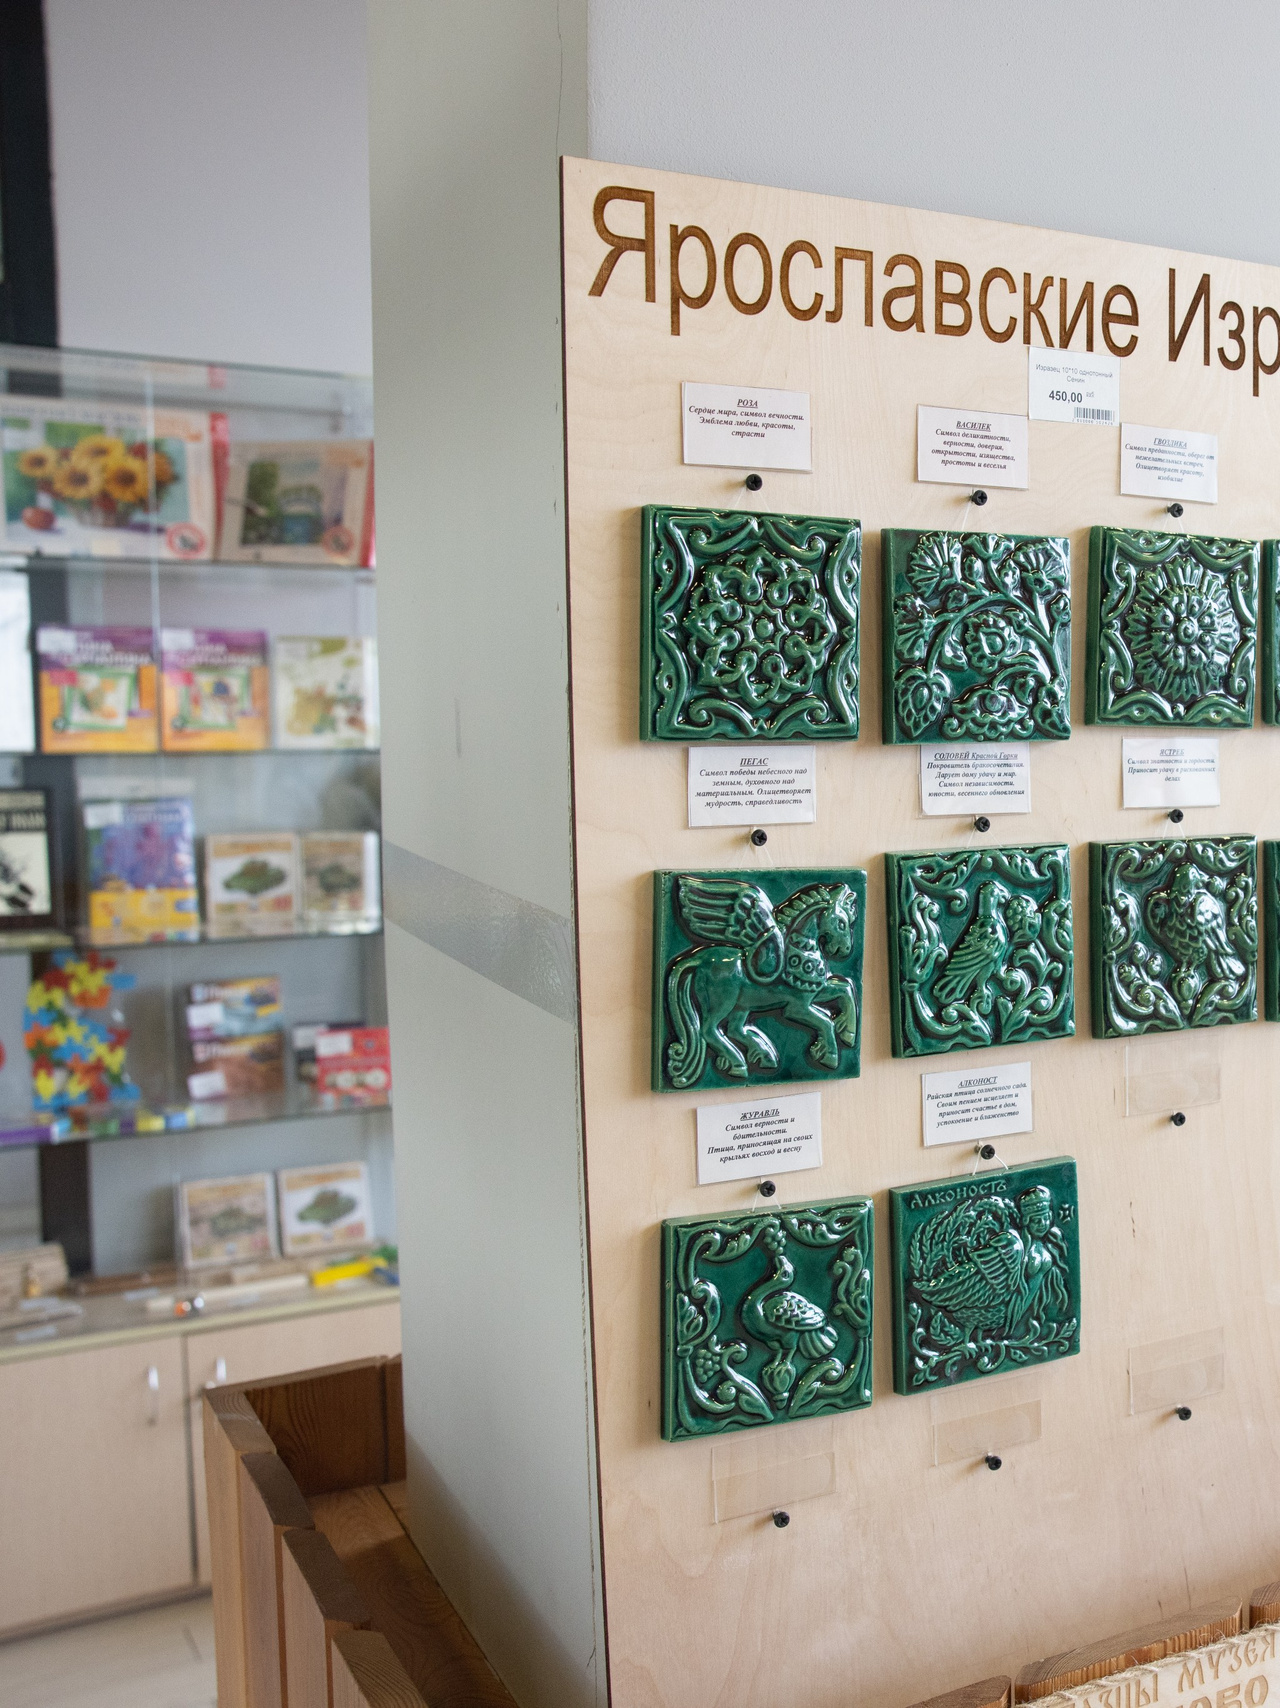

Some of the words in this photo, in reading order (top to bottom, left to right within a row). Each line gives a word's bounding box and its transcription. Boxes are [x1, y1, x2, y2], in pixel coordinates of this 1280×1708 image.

[588, 185, 1139, 357] Ярославские
[1036, 364, 1060, 373] Изразец
[1049, 390, 1082, 404] 450,00
[737, 399, 758, 407] РОЗА
[689, 406, 715, 414] Сердце
[700, 417, 732, 425] Эмблема
[761, 422, 795, 430] красоты,
[956, 421, 991, 431] ВАСИЛЕК
[732, 430, 765, 438] страсти
[936, 429, 960, 437] Символ
[962, 431, 1011, 442] деликатности,
[943, 440, 975, 448] верности,
[1125, 443, 1146, 451] Символ
[1154, 438, 1187, 449] ГВОЗДИКА
[932, 449, 977, 457] открытости,
[979, 453, 1015, 461] изящества,
[1135, 455, 1182, 465] нежелательных
[941, 459, 975, 467] простоты
[1136, 463, 1179, 473] Олицетворяет
[934, 752, 969, 760] СОЛОВЕЙ
[740, 758, 768, 767] ПЕГАС
[927, 762, 970, 770] Покровитель
[695, 790, 754, 798] материальным.
[705, 800, 743, 808] мудрость,
[745, 799, 802, 807] справедливость
[958, 1076, 998, 1088] АЛКОНОСТ
[977, 1084, 1011, 1094] солнечного
[959, 1097, 982, 1105] пением
[984, 1094, 1013, 1102] исцеляет
[740, 1109, 780, 1121] ЖУРАВЛЬ
[939, 1109, 970, 1117] приносит
[972, 1104, 997, 1112] счастье
[936, 1117, 973, 1128] успокоение
[980, 1110, 1019, 1120] блаженство
[726, 1122, 752, 1131] Символ
[755, 1118, 788, 1128] верности
[707, 1146, 735, 1154] Птица,
[737, 1139, 781, 1151] приносящая
[793, 1134, 813, 1142] своих
[720, 1153, 750, 1163] крыльях
[752, 1149, 775, 1158] восход
[783, 1145, 802, 1155] весну
[1178, 1631, 1276, 1693] МУЗЕЯ
